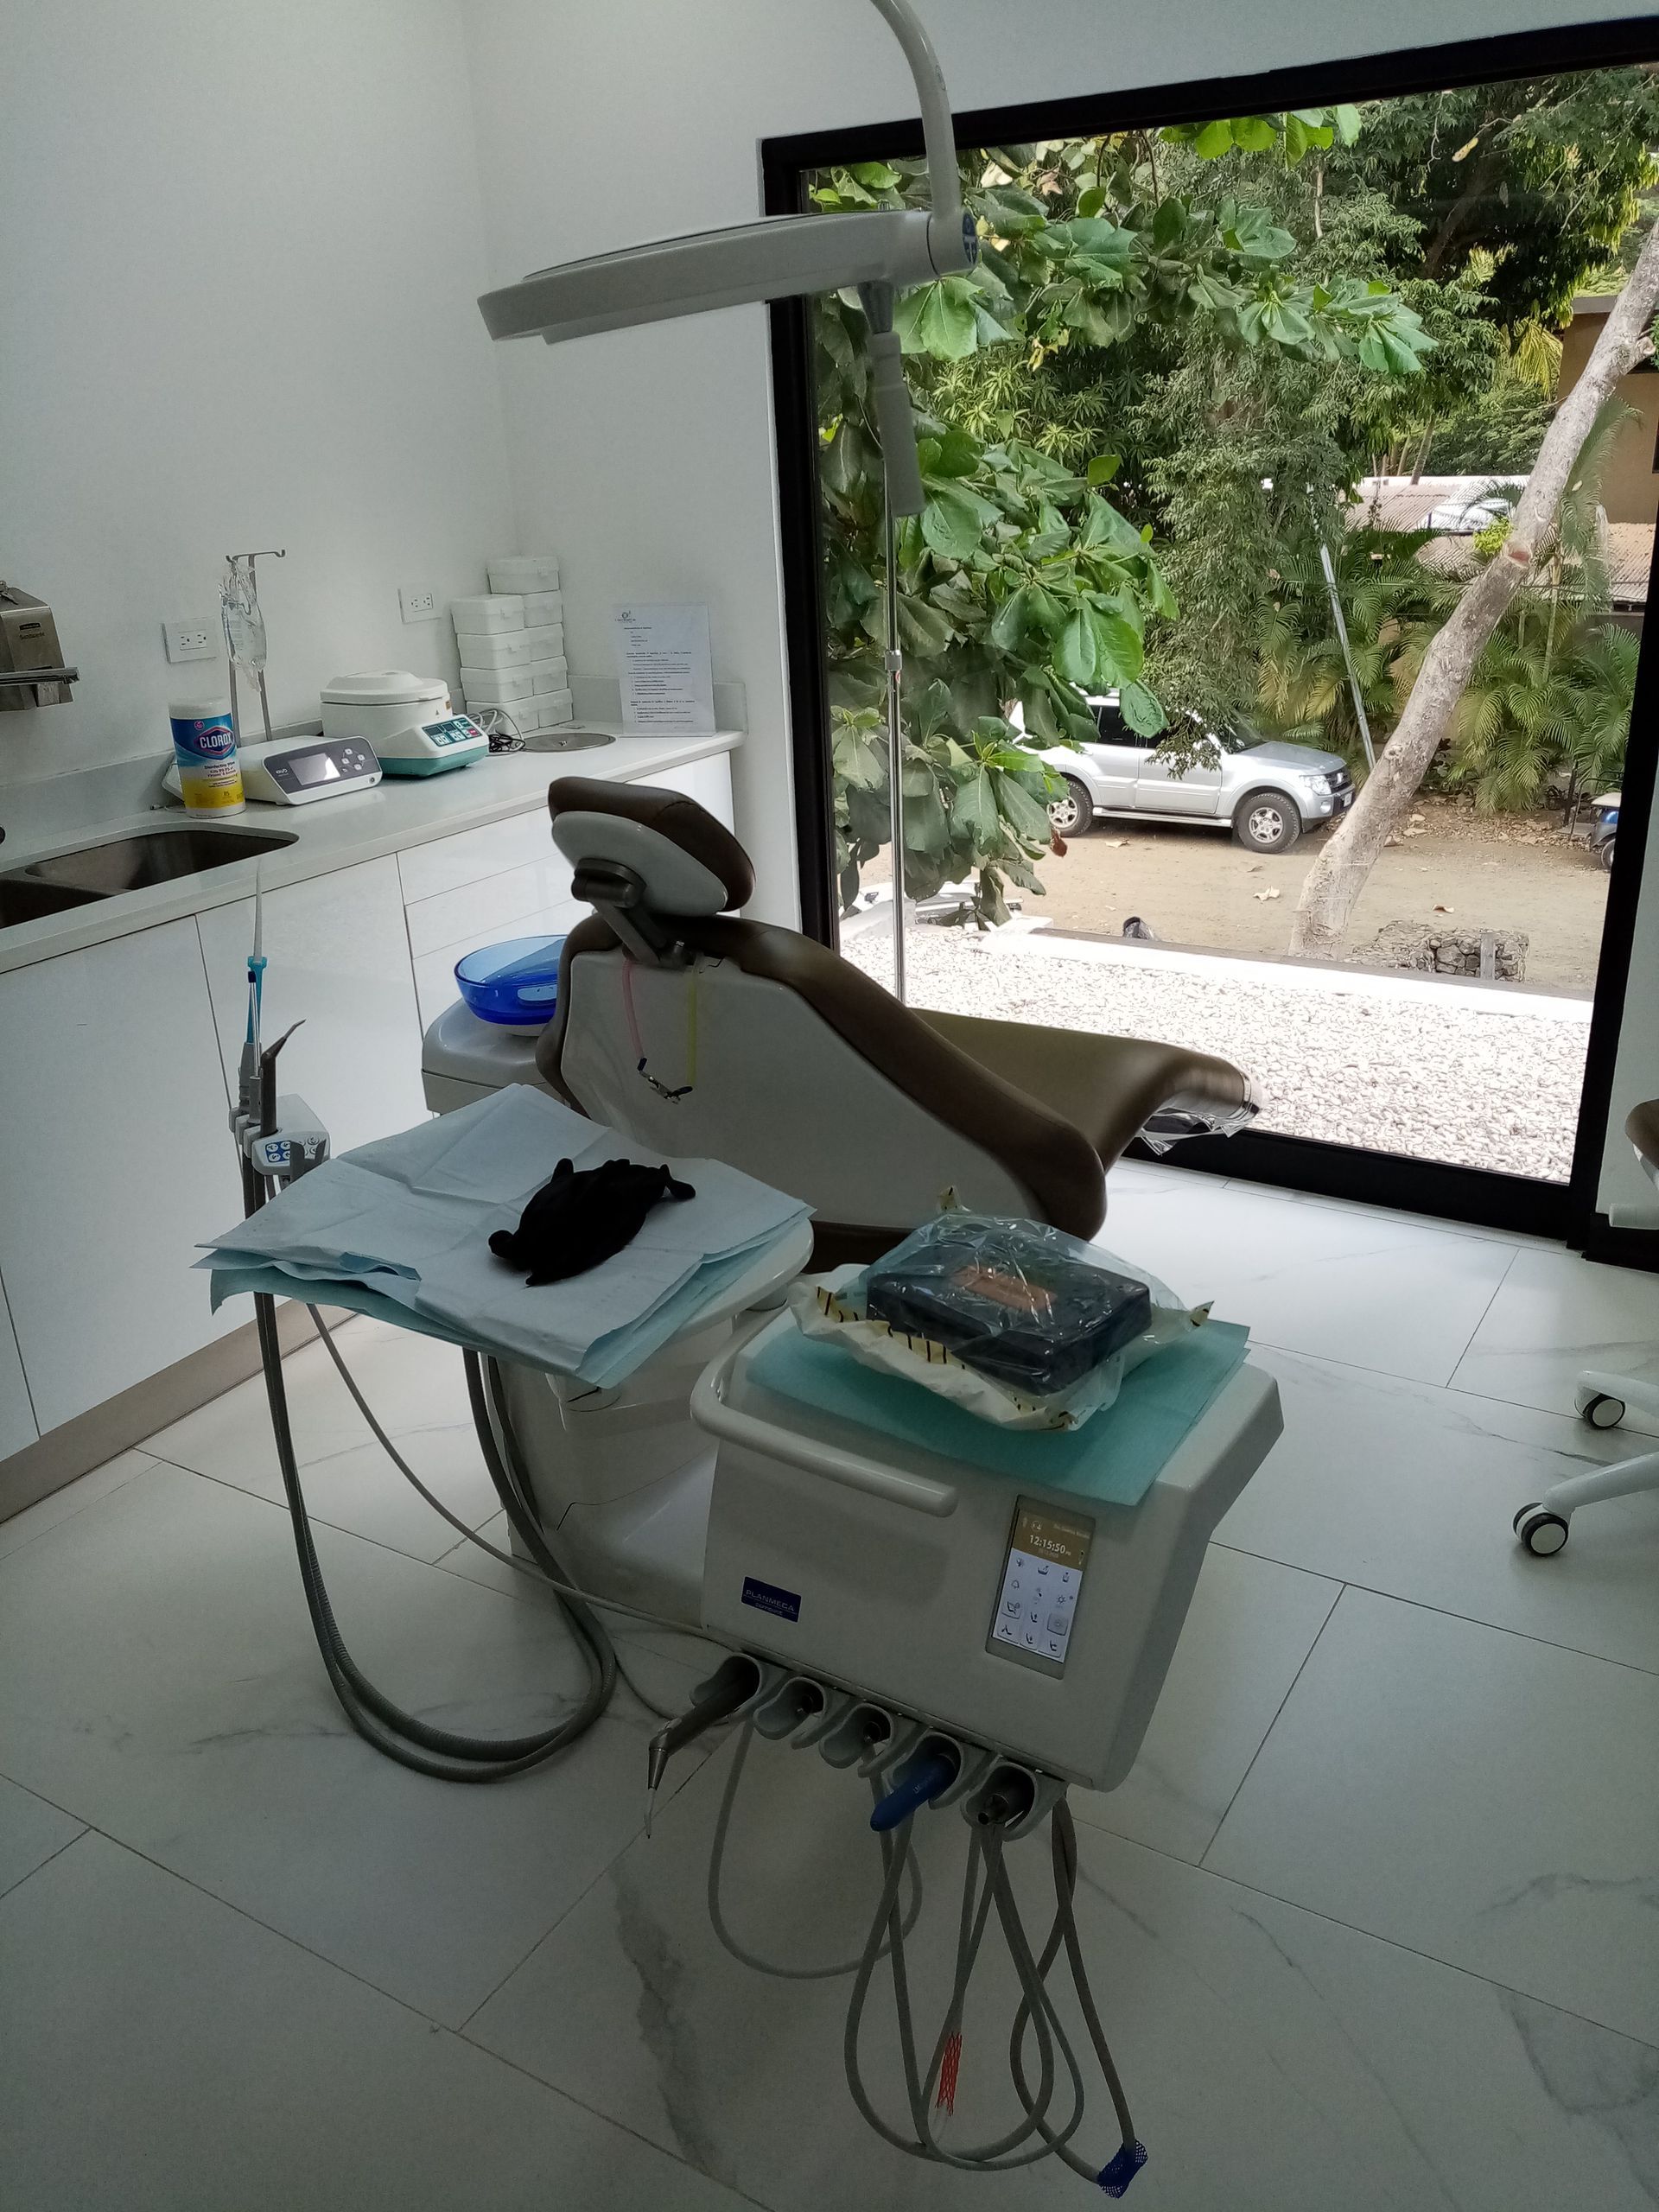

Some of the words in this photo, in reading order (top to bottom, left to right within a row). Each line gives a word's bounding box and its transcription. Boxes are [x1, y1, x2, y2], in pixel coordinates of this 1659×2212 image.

[200, 733, 232, 748] CLOROX
[1030, 1535, 1065, 1554] 12:15:50
[746, 1589, 794, 1611] PLANMECA
